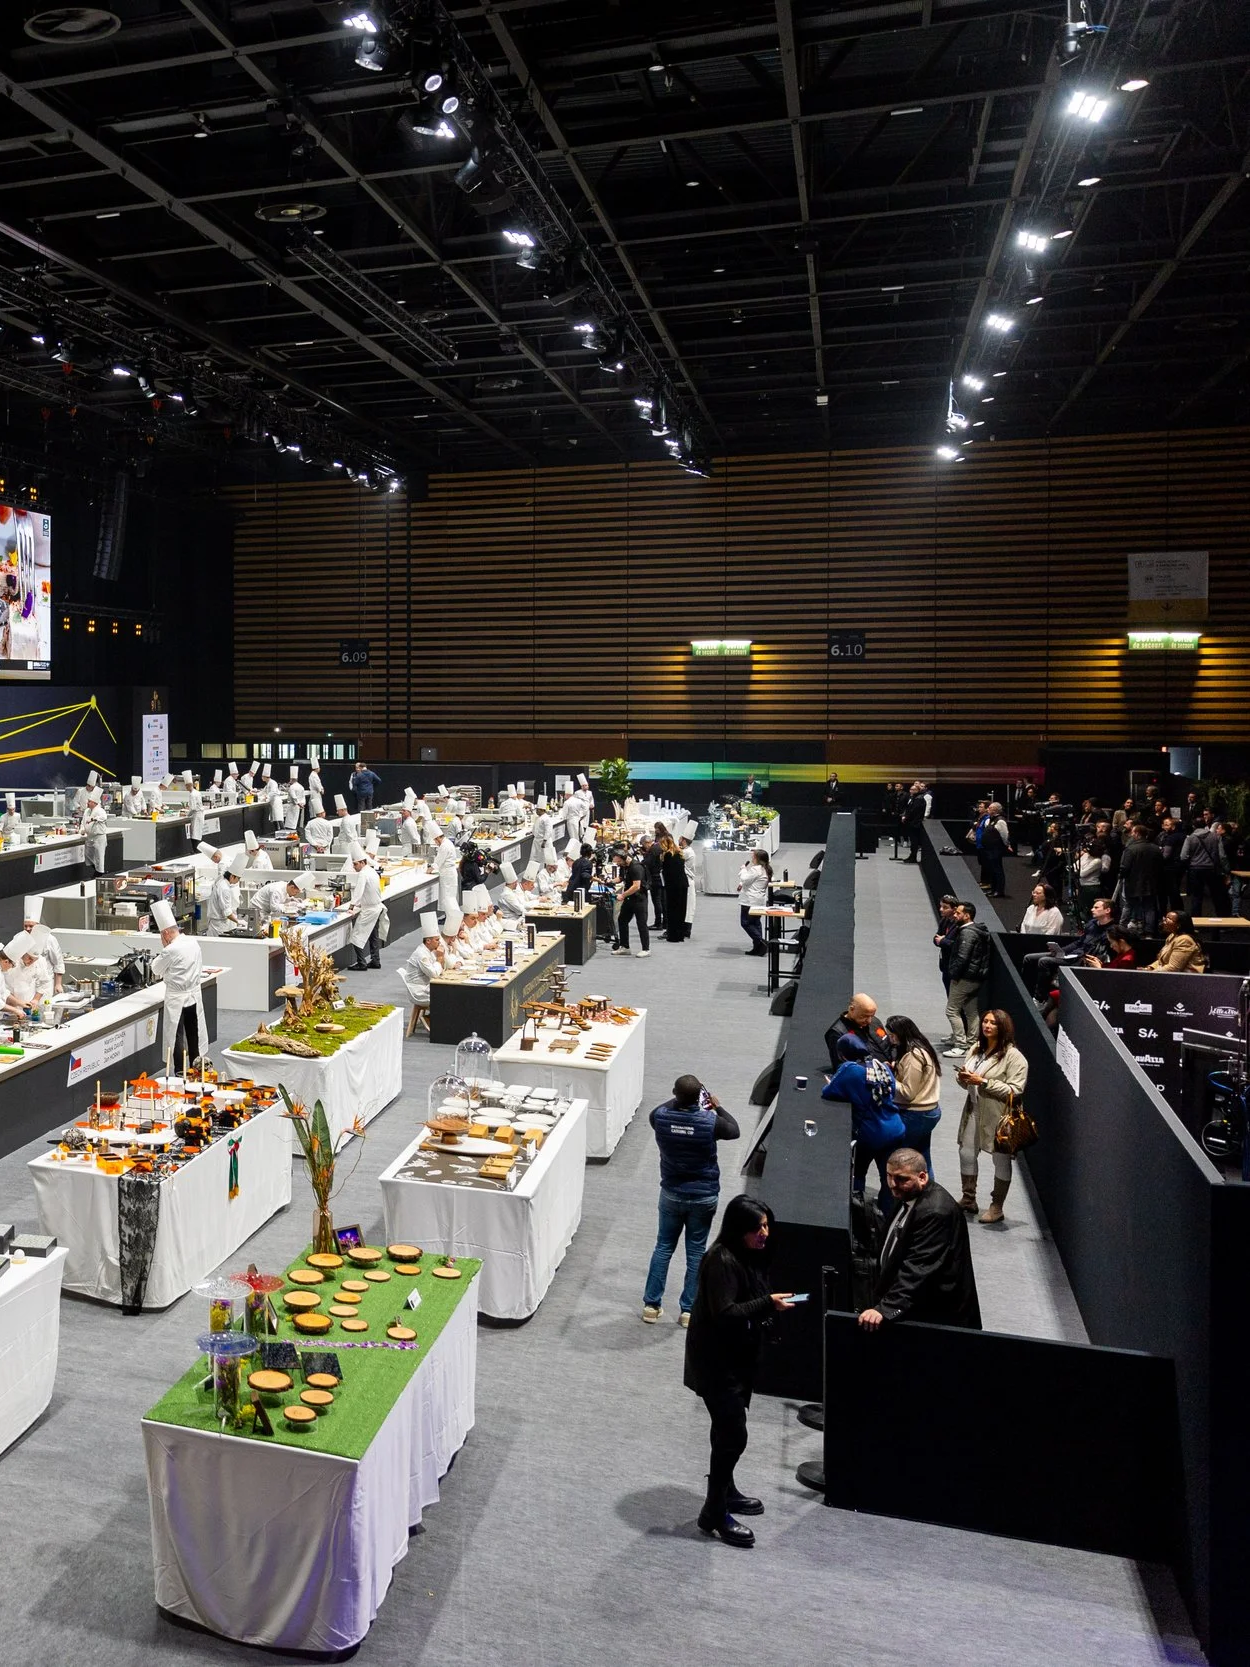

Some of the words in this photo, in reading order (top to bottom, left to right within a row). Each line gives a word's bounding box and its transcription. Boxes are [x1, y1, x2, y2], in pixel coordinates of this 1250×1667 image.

[830, 644, 863, 656] 6.10
[341, 651, 367, 663] 6.09
[1133, 1054, 1165, 1064] AVAZZA
